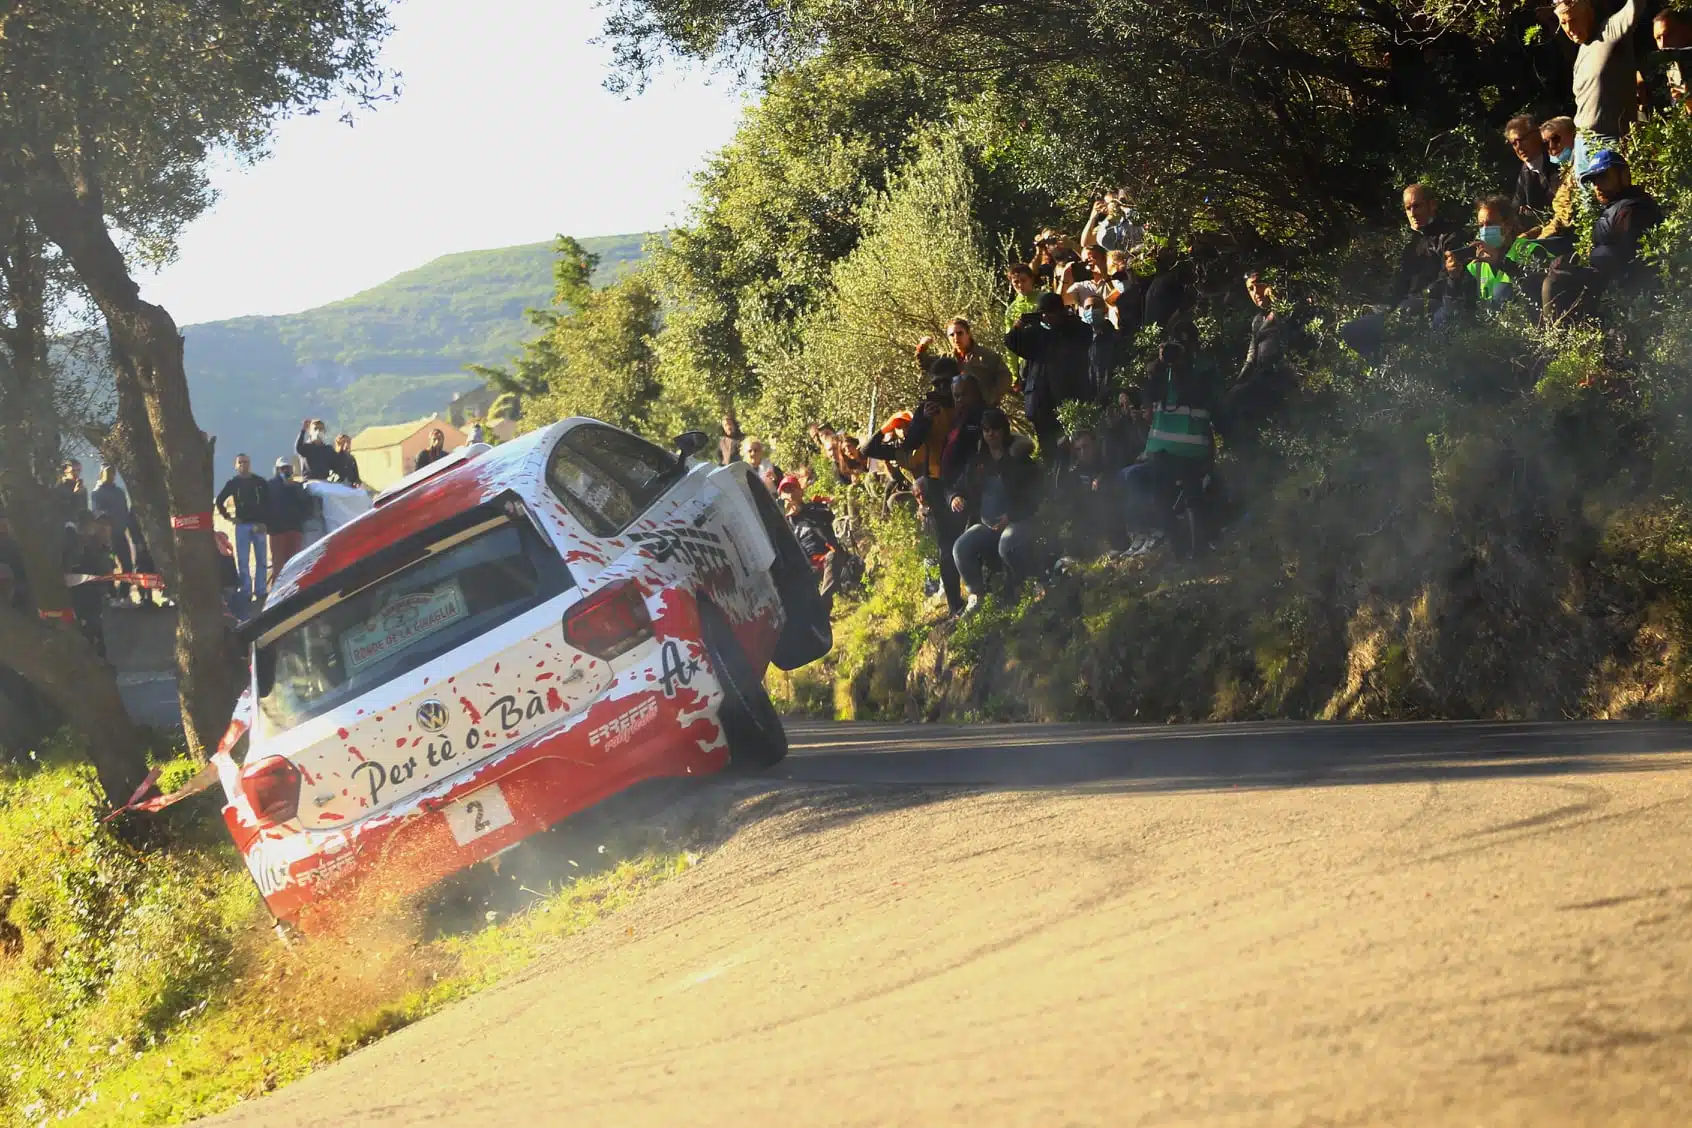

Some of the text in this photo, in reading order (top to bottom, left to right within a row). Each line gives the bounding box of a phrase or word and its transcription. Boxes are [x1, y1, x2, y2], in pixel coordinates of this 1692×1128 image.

[351, 689, 546, 806] Per tè o Bà
[466, 799, 491, 833] 2
